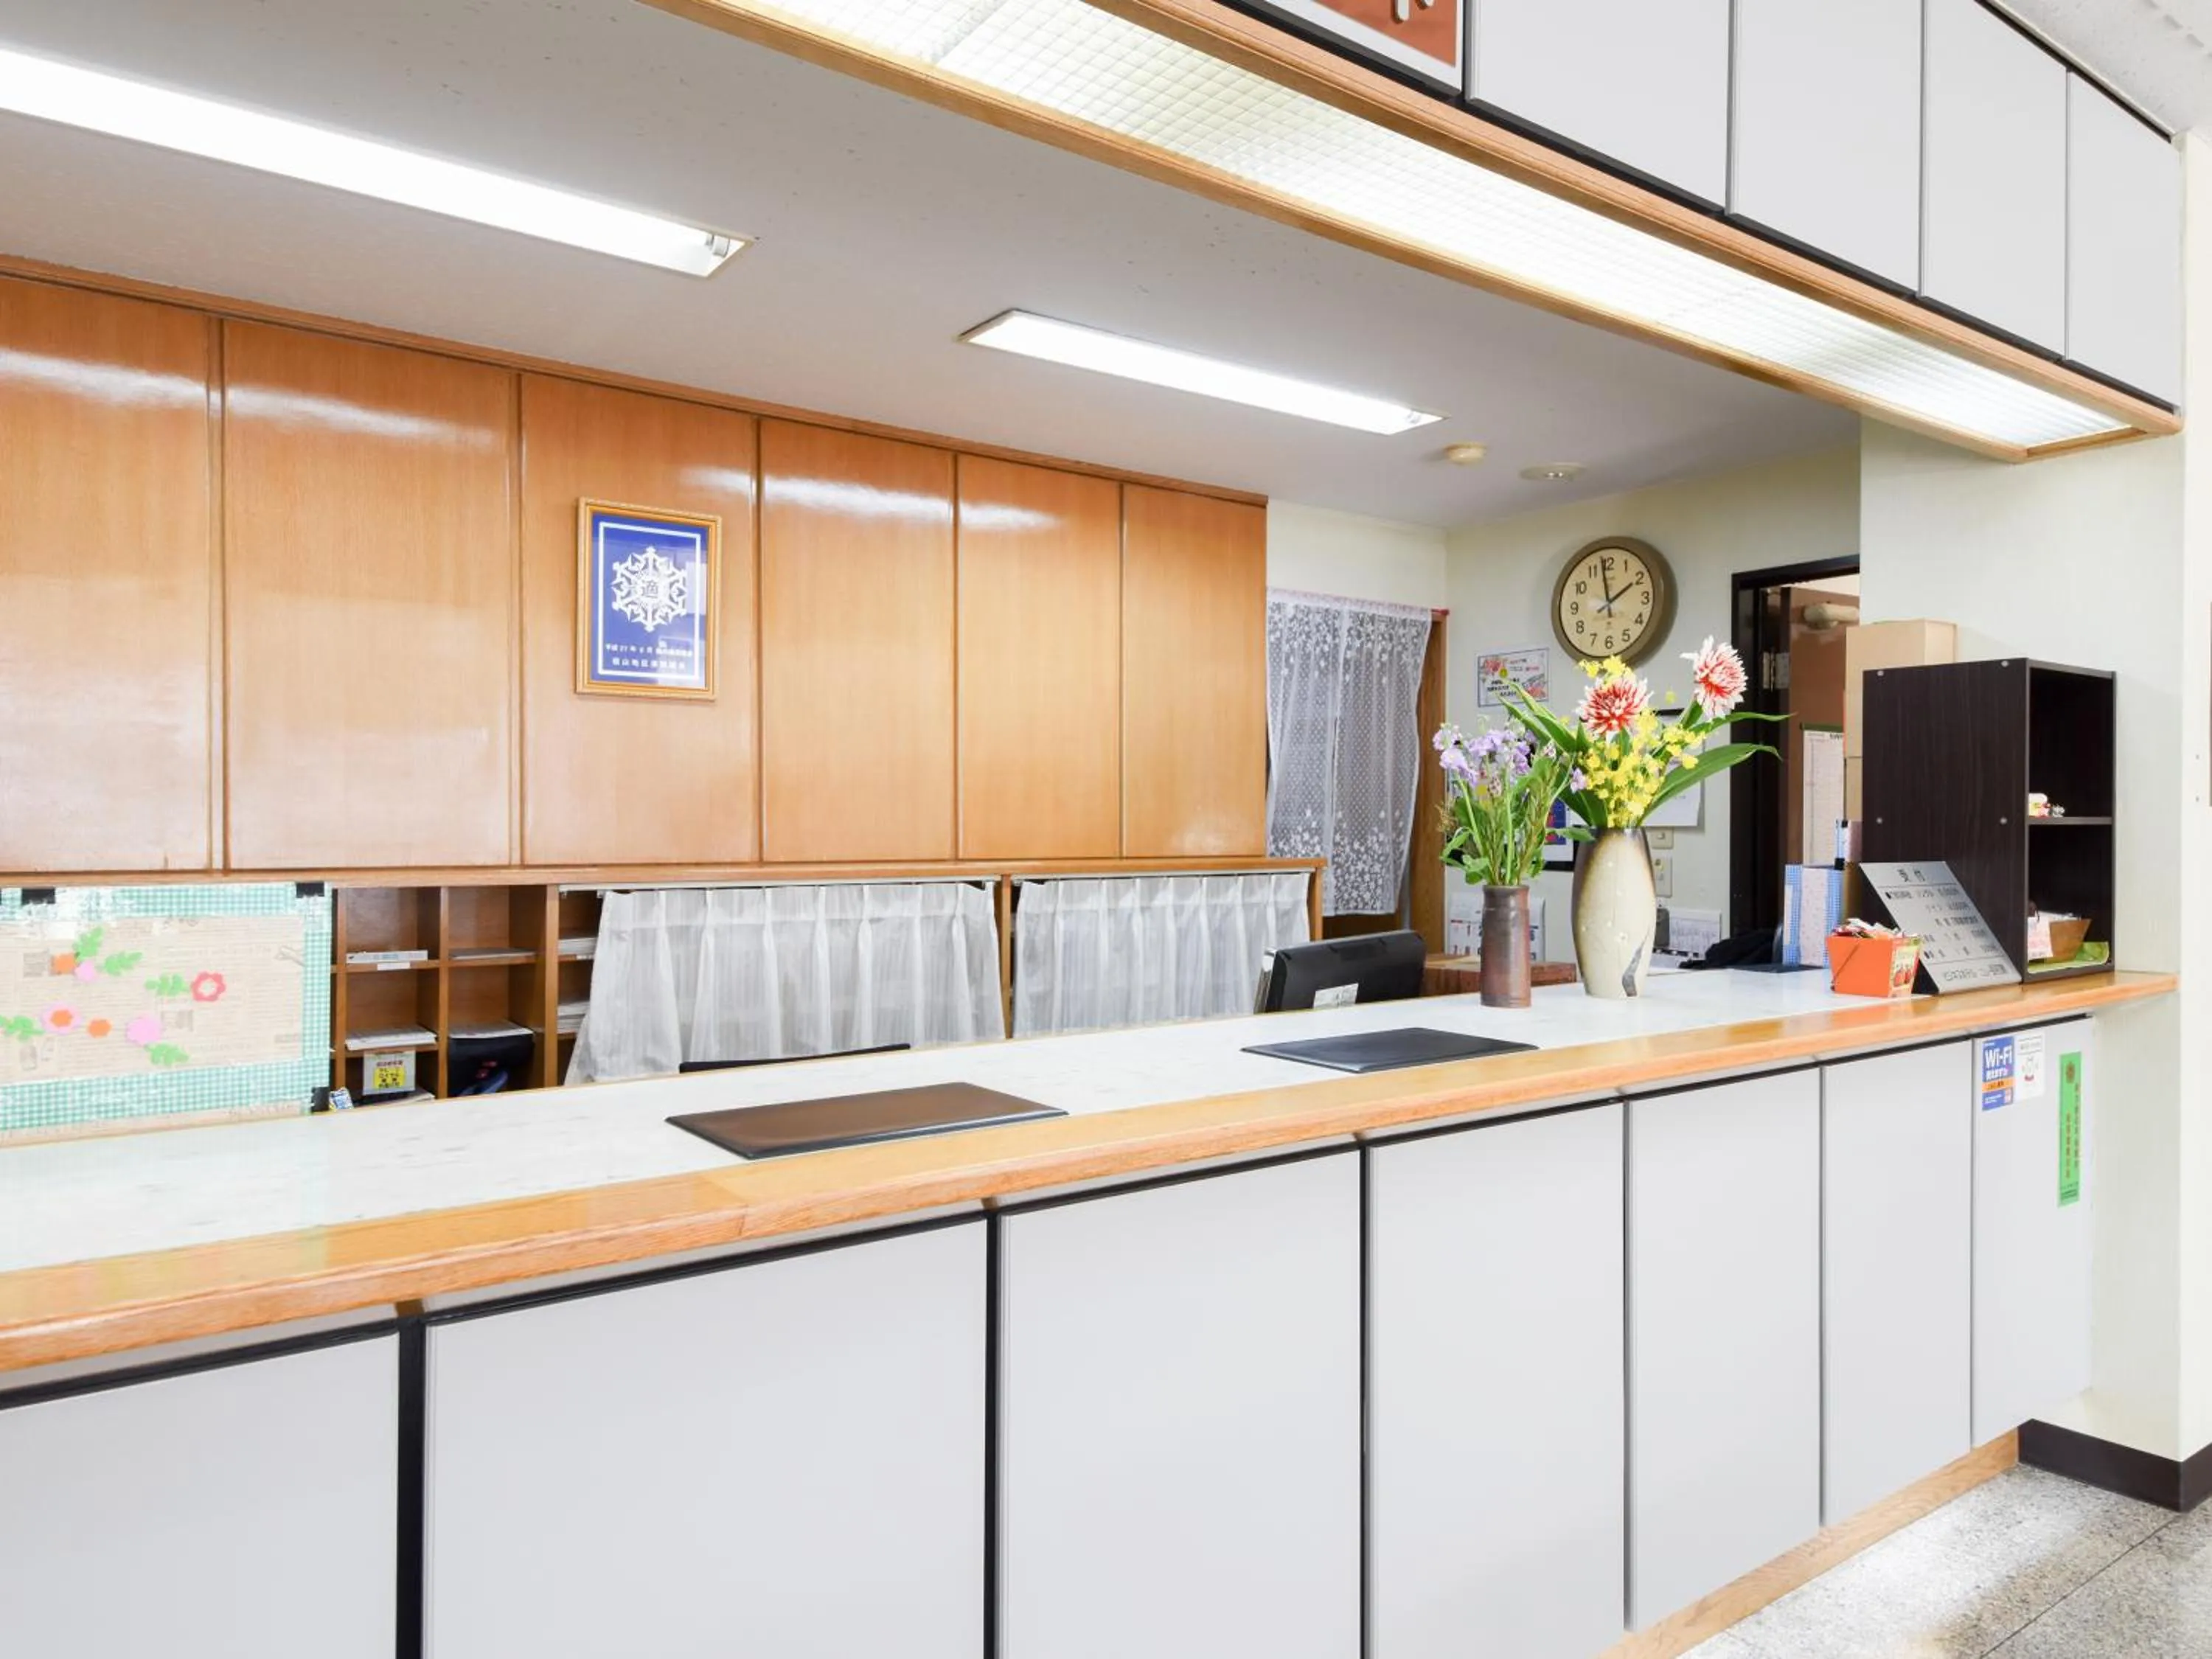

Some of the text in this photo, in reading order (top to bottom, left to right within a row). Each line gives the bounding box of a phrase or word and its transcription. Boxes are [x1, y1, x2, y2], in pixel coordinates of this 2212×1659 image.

[1588, 565, 1598, 579] 11
[1624, 559, 1628, 573] 1
[1635, 571, 1644, 585] 2
[1575, 581, 1587, 595] 10
[1641, 591, 1650, 605] 3
[1570, 602, 1579, 615] 9
[1634, 612, 1644, 625] 4
[1576, 620, 1585, 634] 8
[1589, 633, 1598, 647] 7
[1621, 628, 1631, 642] 5
[1604, 636, 1614, 650] 6
[1984, 1045, 2013, 1069] Wi-Fi
